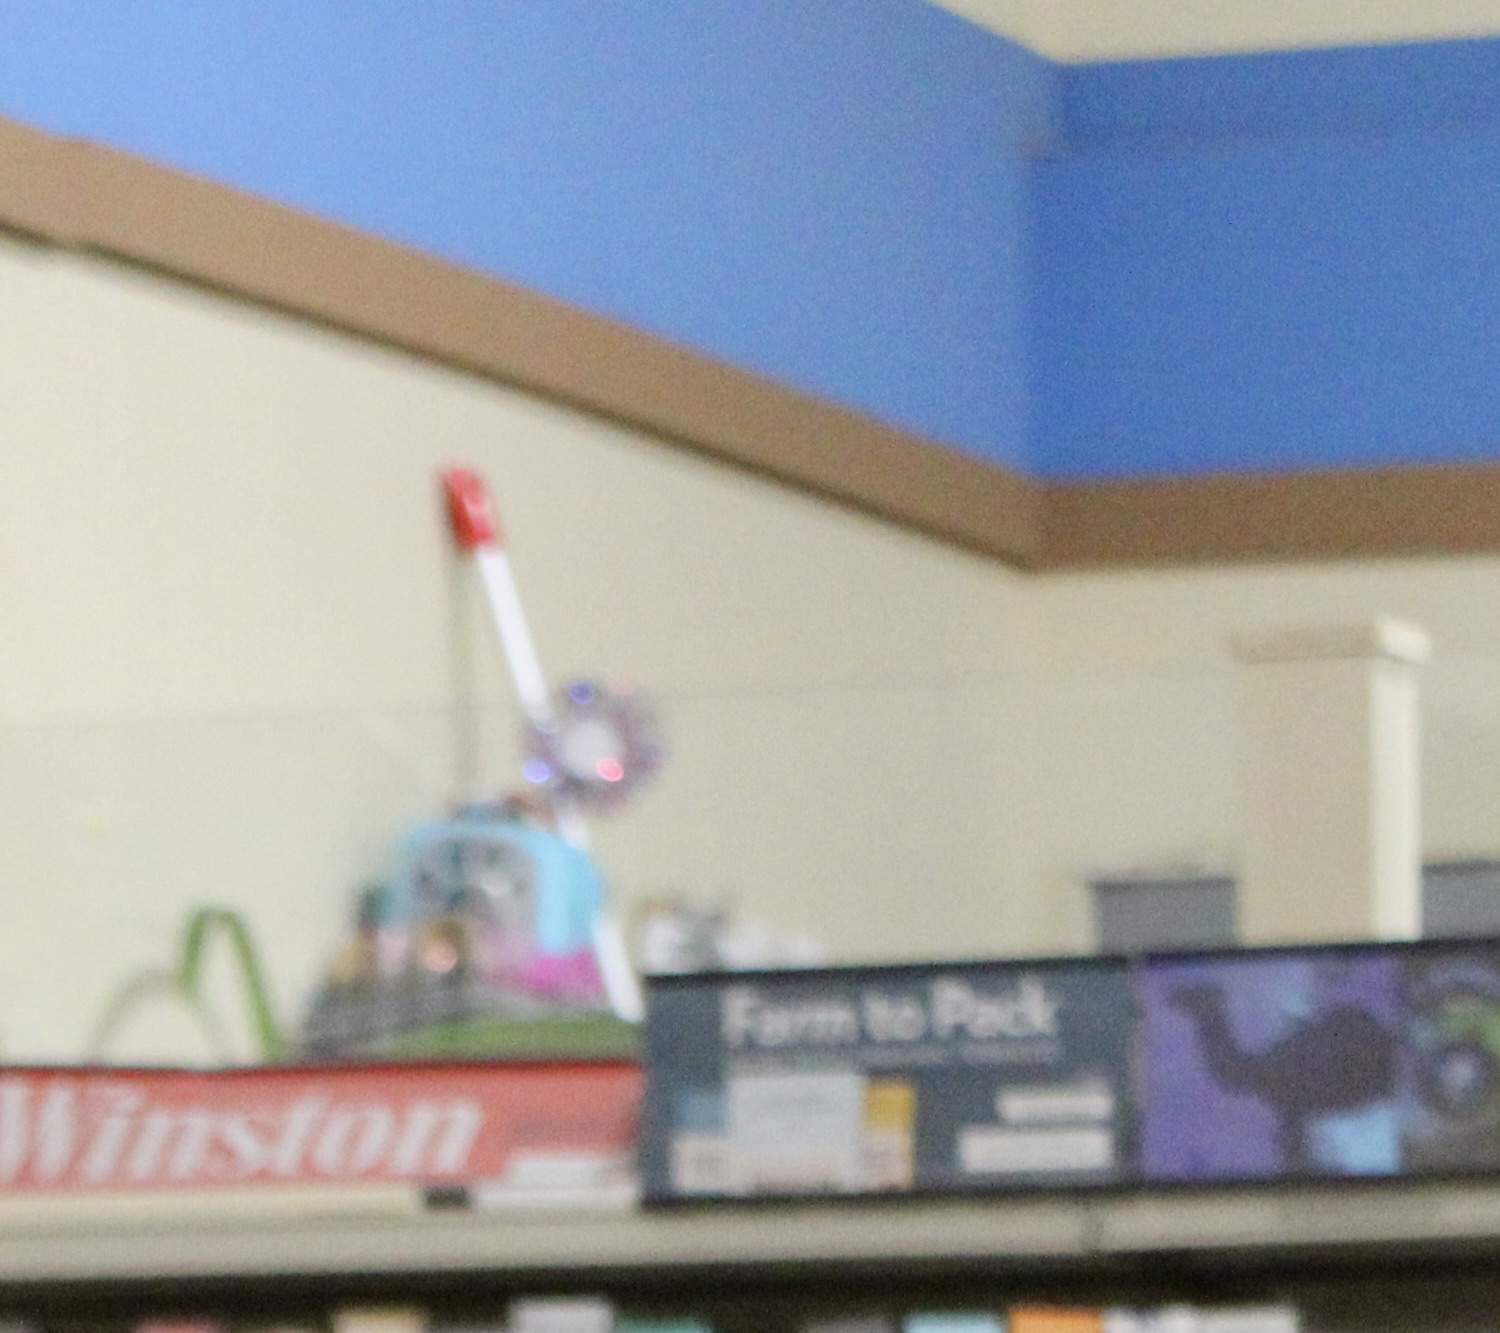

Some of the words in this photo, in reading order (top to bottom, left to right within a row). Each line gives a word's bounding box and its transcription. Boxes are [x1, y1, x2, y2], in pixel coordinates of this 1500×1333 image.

[722, 990, 857, 1048] Farm
[864, 990, 925, 1042] to
[929, 977, 1060, 1041] Pack
